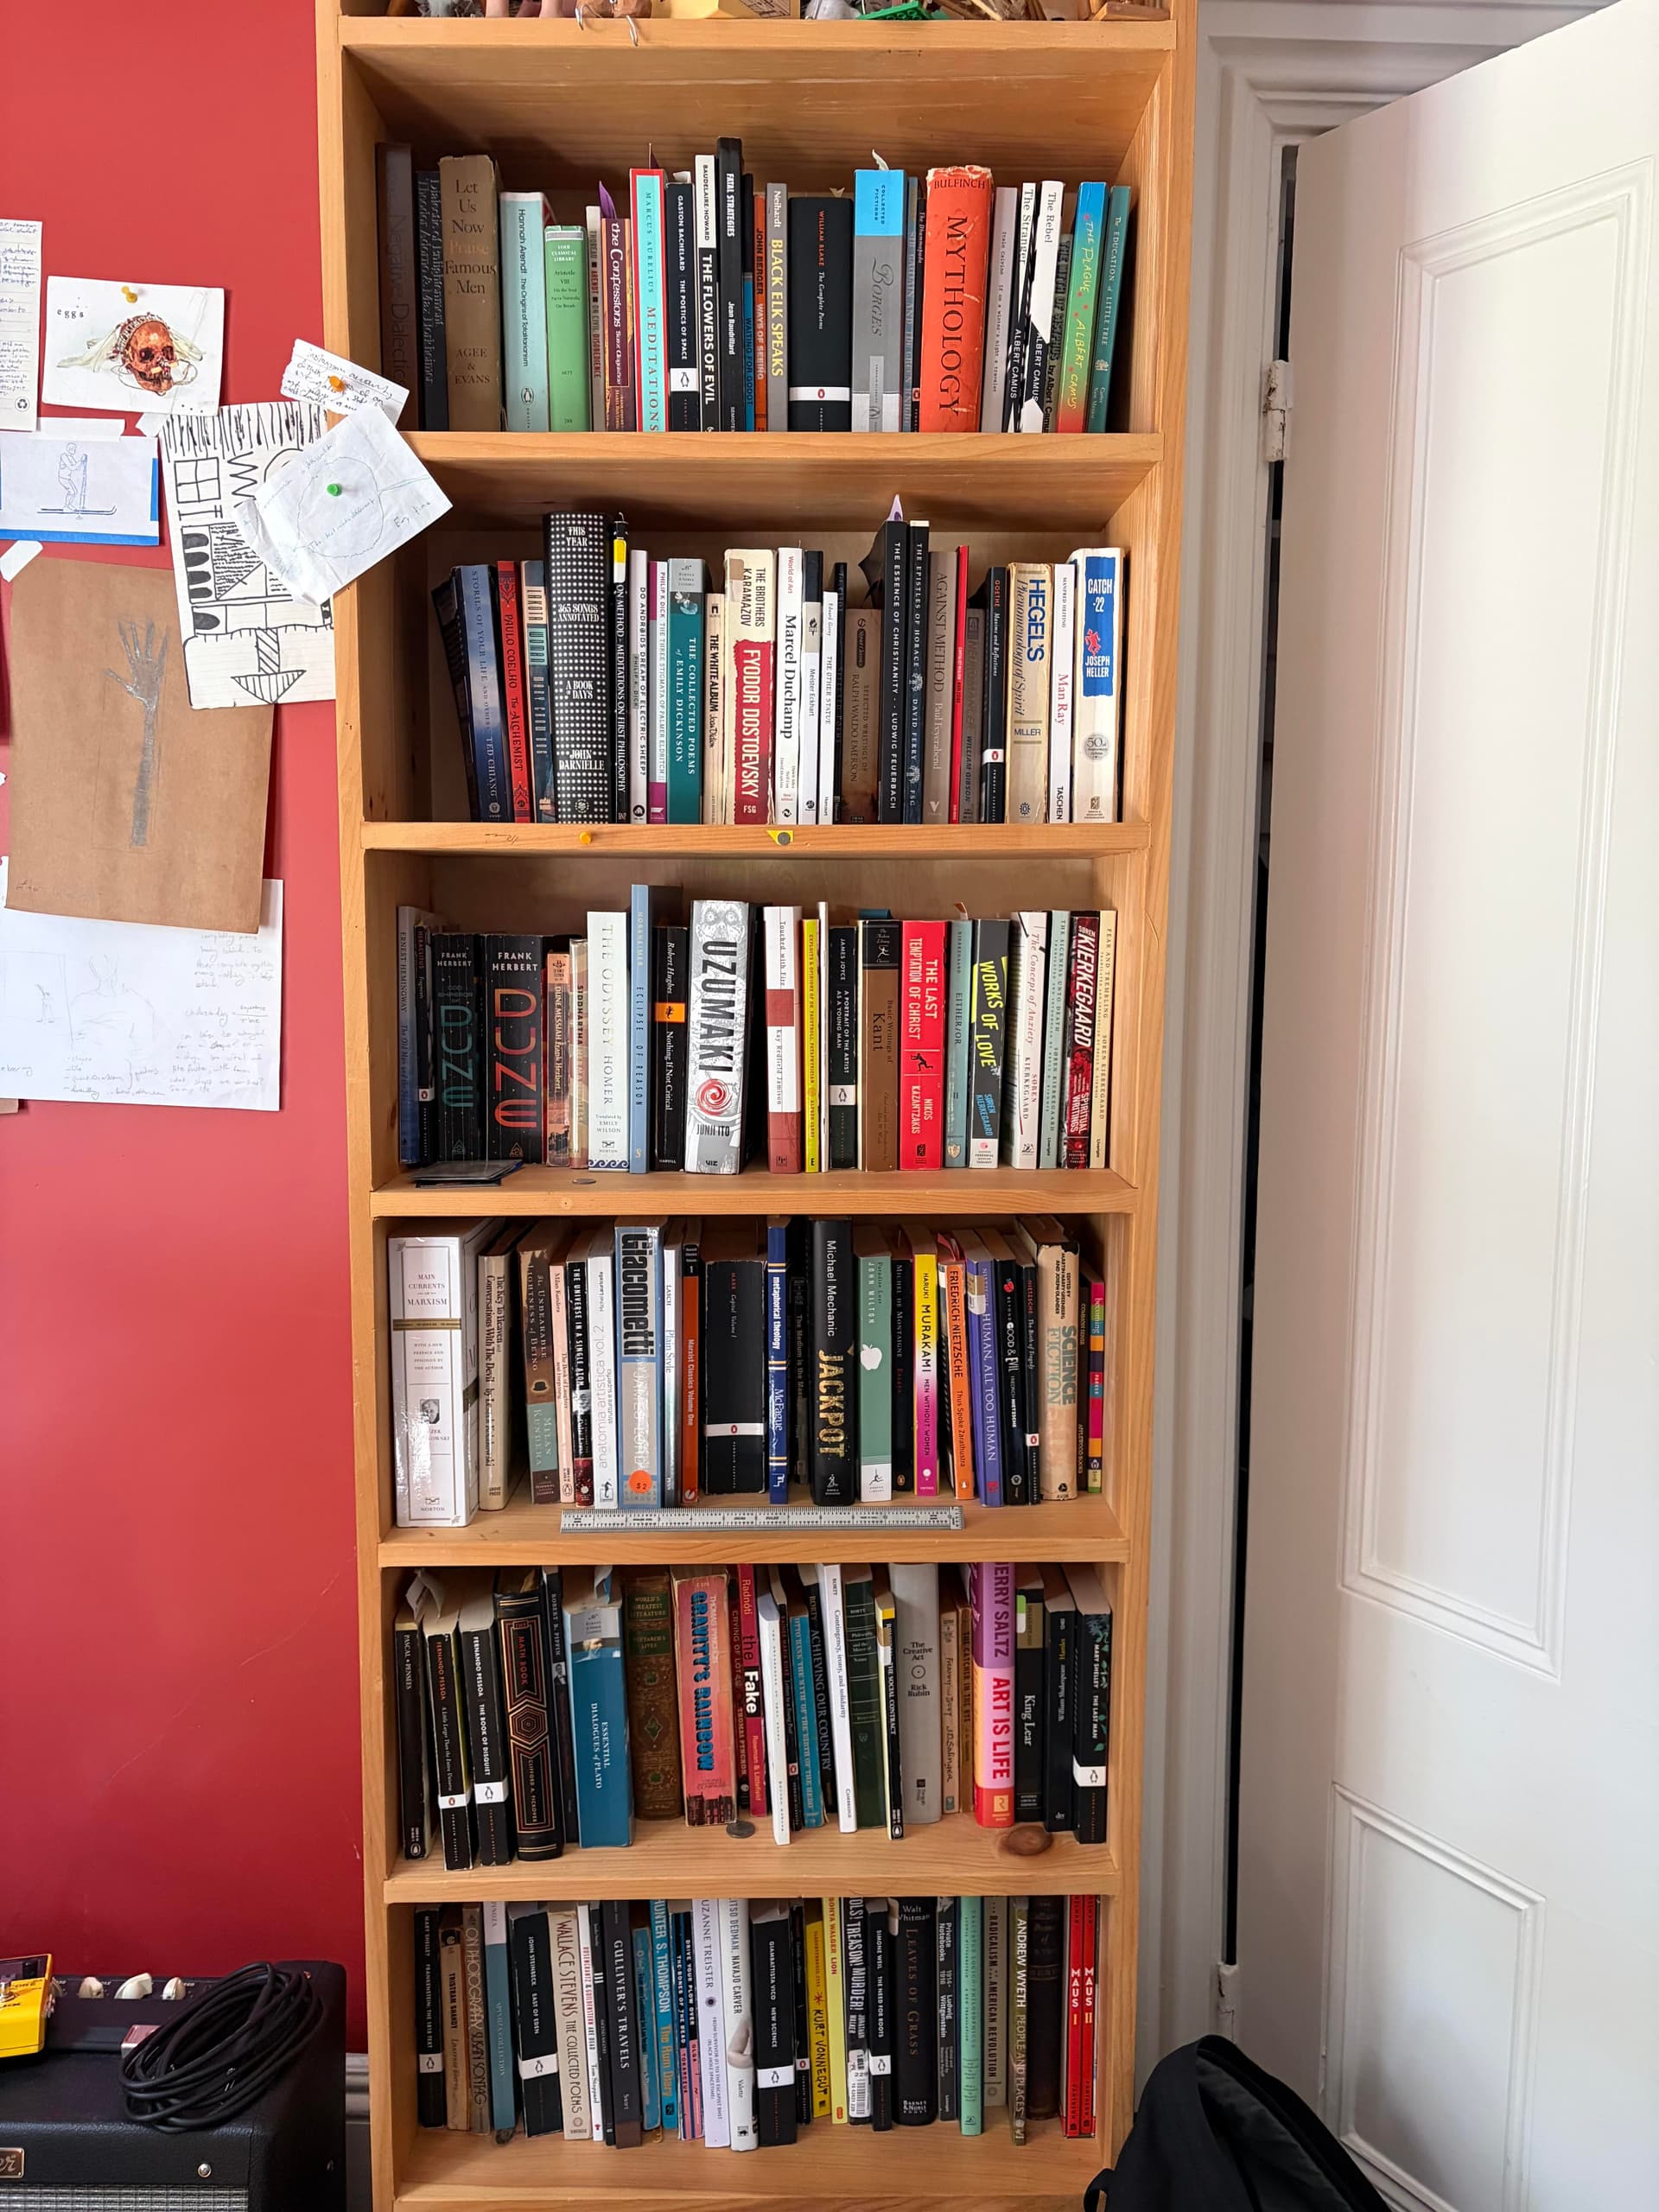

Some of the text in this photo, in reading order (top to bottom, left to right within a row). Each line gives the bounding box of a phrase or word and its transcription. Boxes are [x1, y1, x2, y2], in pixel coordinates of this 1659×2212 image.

[455, 180, 478, 194] Let
[459, 200, 477, 213] Us
[726, 174, 735, 238] FATAL STRATEGIES
[934, 179, 986, 189] BULFINCH
[452, 219, 484, 233] Now
[1019, 189, 1033, 264] The Stranger
[1045, 193, 1057, 243] The Rebel
[445, 261, 496, 275] Famous
[457, 280, 485, 294] Men
[772, 190, 784, 377] Neihardt BLACK ELK SPEAKS
[57, 308, 84, 319] eggs
[702, 254, 715, 404] THE FLOWERS OF EVIL
[939, 216, 968, 416] MYTHOLOGY
[646, 307, 659, 431] MEDITATIONS
[566, 537, 588, 547] YEAR
[567, 526, 586, 537] THIS
[741, 568, 753, 627] KARAMAZOV
[754, 568, 766, 627] THE BROTHERS
[1088, 578, 1113, 594] CATCH
[505, 614, 514, 645] PAULO
[893, 611, 899, 625] OF
[1027, 579, 1046, 663] HEGEL'S
[506, 650, 518, 689] COELHO
[780, 615, 797, 740] Marcel Duchamp
[892, 627, 900, 695] CHRISTIANITY
[1085, 655, 1110, 666] JOSEPH
[1086, 667, 1109, 678] HELLER
[510, 711, 523, 772] ALCHEMIST
[741, 649, 761, 798] FYODOR DOSTOEVSKY
[890, 713, 899, 749] LUDWIG
[1014, 728, 1042, 736] MILLER
[558, 760, 605, 771] DARNIELLE
[569, 749, 593, 760] JOHN
[889, 753, 898, 809] FEUERBACH
[492, 963, 538, 972] HERBERT
[498, 951, 532, 961] FRANK
[665, 968, 675, 995] Hughes
[601, 925, 613, 1105] THE ODYSSEY HOMER
[698, 940, 737, 1072] UZUMAKI
[908, 938, 923, 1040] TEMPTATION OF CHRIST
[925, 959, 938, 1020] THE LAST
[975, 960, 1003, 1068] WORKS OF LOVE
[1074, 932, 1096, 1047] KIERKEGAARD
[494, 988, 537, 1128] DUNE
[873, 1013, 885, 1052] Kant
[696, 1124, 730, 1136] JUNJI ITO
[911, 1085, 921, 1135] KAZANTZAKIS
[924, 1098, 933, 1121] NIKOS
[407, 1297, 448, 1306] MARXISM
[621, 1233, 655, 1356] Giacometti
[772, 1276, 781, 1350] metaphorical theology
[826, 1240, 837, 1337] Michael Mechanic
[921, 1304, 932, 1372] MURAKAMI
[950, 1270, 964, 1378] FRIEDRICH NIETZSCHE
[982, 1313, 996, 1461] HUMAN, ALL TOO HUMAN
[1046, 1327, 1062, 1405] FICTION
[1061, 1325, 1077, 1406] SCIENCE
[773, 1389, 785, 1431] McFague
[818, 1349, 845, 1459] JACKPOT
[957, 1407, 965, 1427] Spoke
[994, 1611, 1010, 1658] SALTZ
[474, 1636, 484, 1697] FERNANDO PESSOA
[691, 1591, 715, 1771] GRAVITY'S RAINBOW
[743, 1635, 760, 1714] the Fake
[480, 1716, 488, 1734] BOOK
[811, 1629, 831, 1770] ACHIEVING OUR COUNTRY
[1021, 1695, 1036, 1747] King Lear
[481, 1736, 488, 1745] OF
[591, 1702, 601, 1754] DIALOGUES
[601, 1722, 611, 1768] ESSENTIAL
[992, 1677, 1010, 1780] ART IS LIFE
[482, 1746, 491, 1776] DISQUIET
[594, 1761, 602, 1789] PLATO
[529, 1955, 537, 1986] STEINBECK
[701, 1899, 714, 1989] UZANNE TREISTER
[846, 1922, 867, 2011] TREASON! MURDER!
[1015, 1918, 1027, 2008] ANDREW WYETH
[613, 1940, 630, 2069] GULLIVER'S TRAVELS
[731, 1955, 743, 2016] NAVAJO CARVER
[1071, 1968, 1081, 2008] MAUS
[1084, 1967, 1095, 2006] MAUS
[556, 1919, 582, 2113] WALLACE STEVENS THE COLLECTED POEMS
[813, 2009, 829, 2095] KURT VONNEGUT
